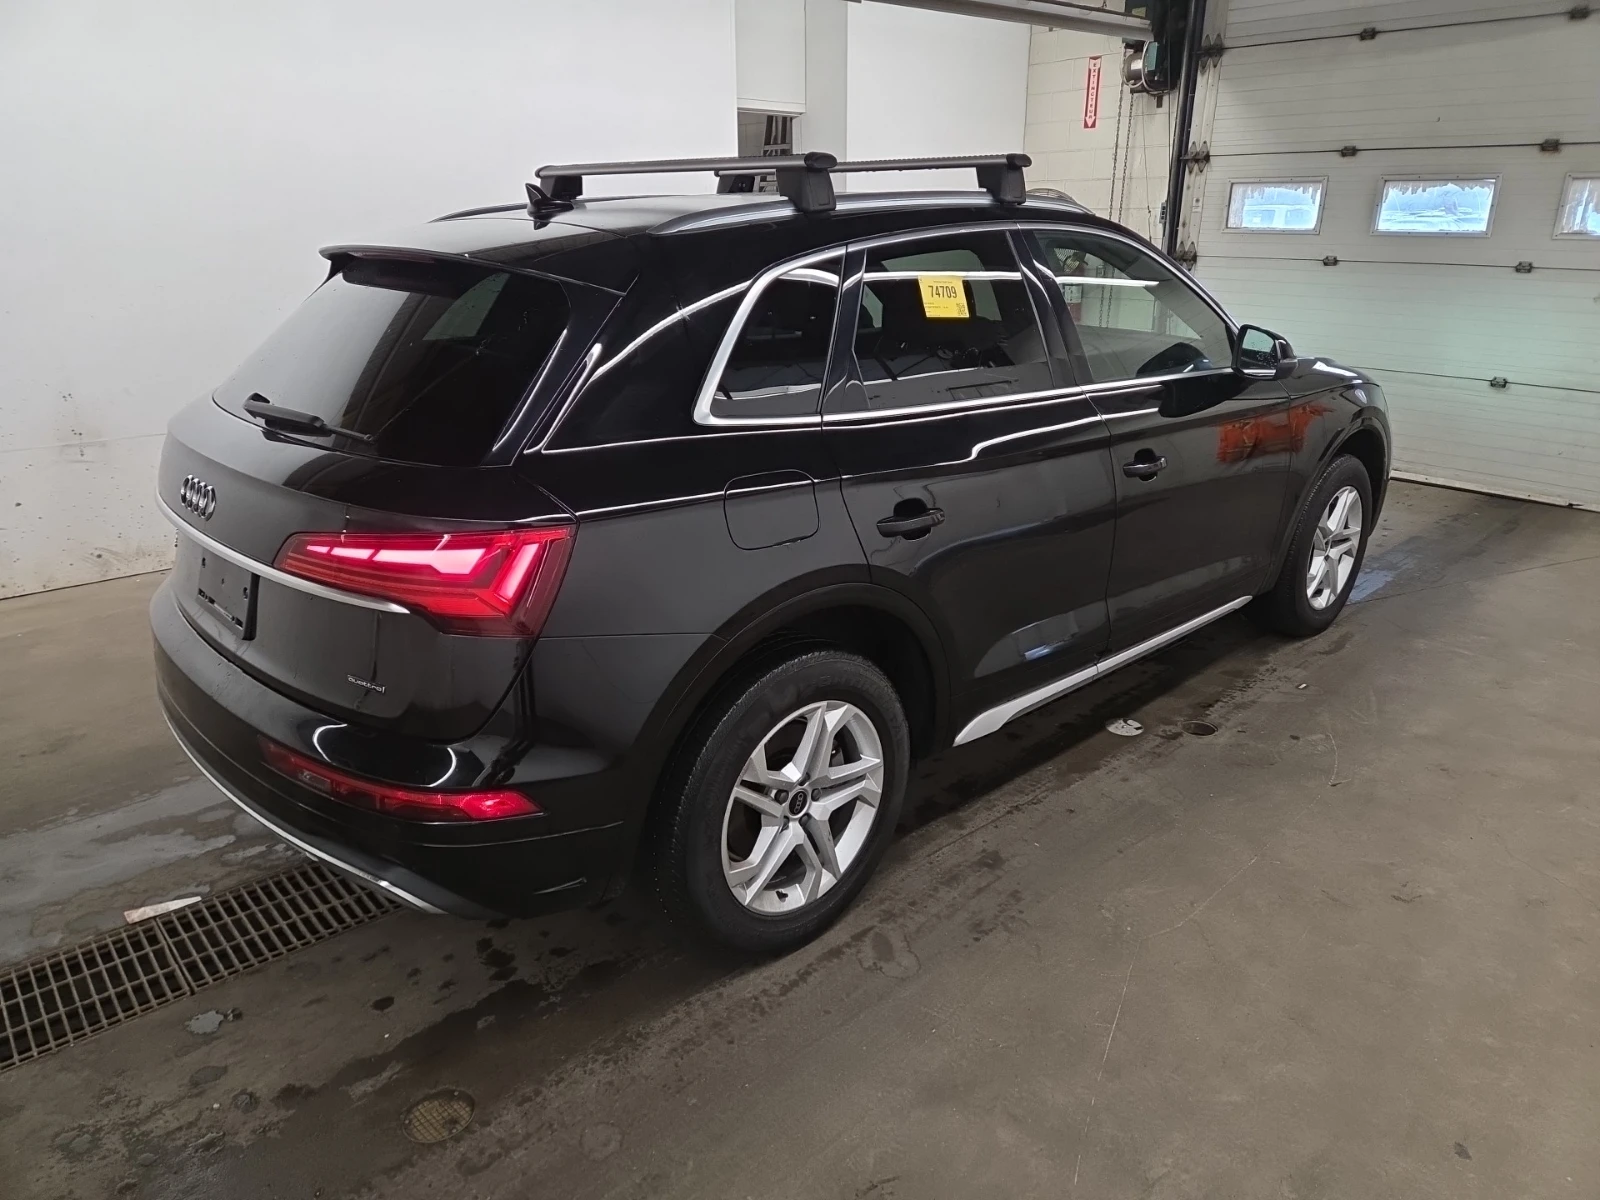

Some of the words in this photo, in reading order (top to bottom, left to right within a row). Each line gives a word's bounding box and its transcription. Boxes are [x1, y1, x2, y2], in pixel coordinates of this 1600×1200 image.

[1088, 62, 1097, 119] EXTINCTEUR
[928, 285, 958, 299] 74709
[348, 677, 382, 692] quattro
